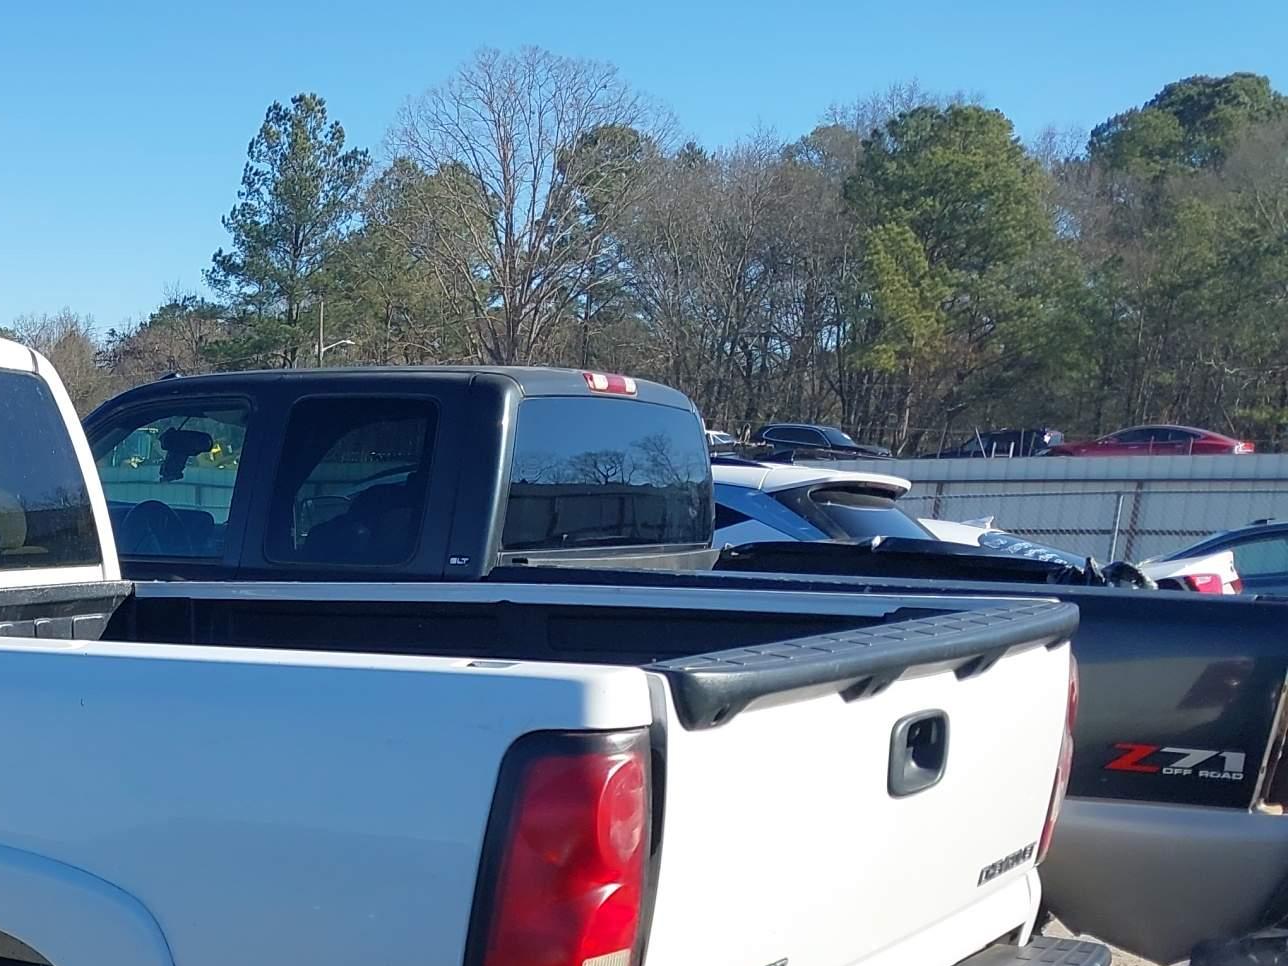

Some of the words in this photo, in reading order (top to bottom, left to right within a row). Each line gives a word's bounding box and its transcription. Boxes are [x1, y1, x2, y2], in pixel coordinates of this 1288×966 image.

[449, 557, 470, 565] SLT
[1103, 742, 1246, 773] Z71
[1162, 767, 1193, 777] OFF
[1199, 770, 1245, 780] ROAD
